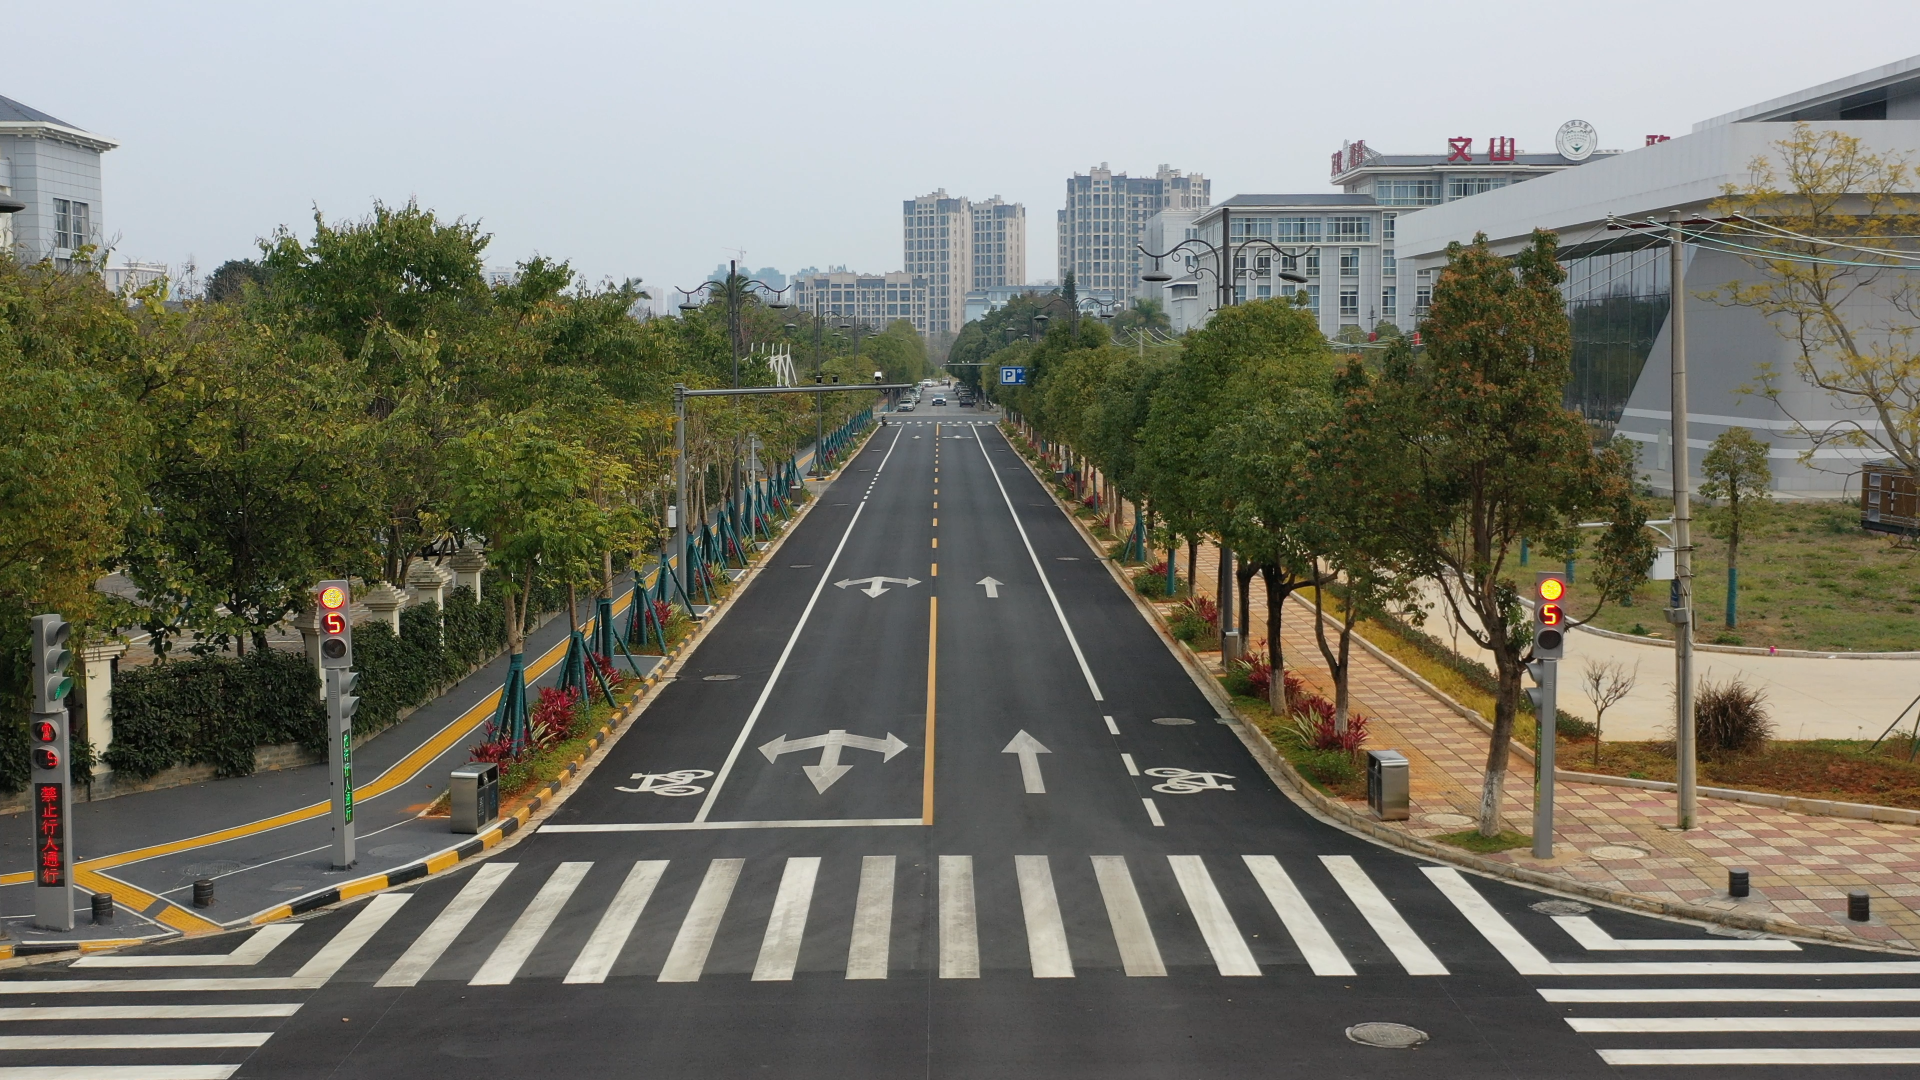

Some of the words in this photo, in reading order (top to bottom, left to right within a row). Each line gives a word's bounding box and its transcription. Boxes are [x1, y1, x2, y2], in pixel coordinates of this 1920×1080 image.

[1448, 136, 1515, 161] 文山
[1005, 370, 1013, 381] P
[327, 613, 341, 634] 5
[1543, 604, 1557, 625] 5
[40, 786, 60, 884] 禁止行人通行
